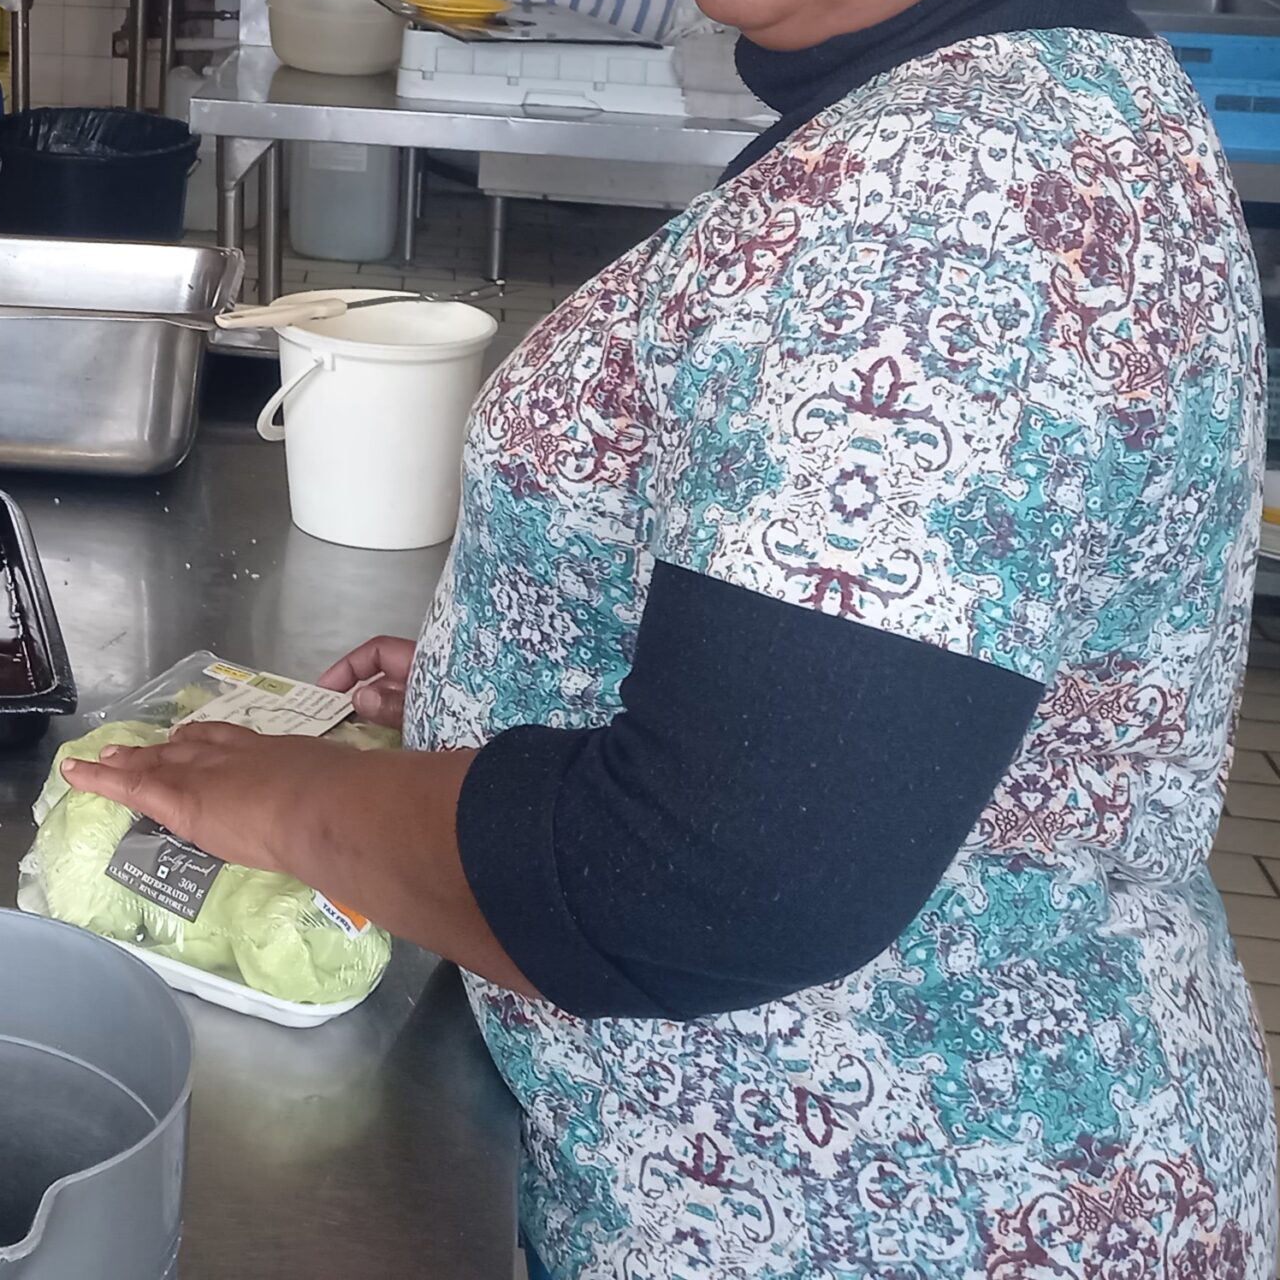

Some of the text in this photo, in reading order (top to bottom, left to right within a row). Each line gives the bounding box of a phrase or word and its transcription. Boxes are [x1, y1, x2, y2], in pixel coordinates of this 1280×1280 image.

[122, 861, 143, 878] KEEP
[109, 866, 130, 881] CLASS
[138, 883, 159, 900] RINSE
[157, 894, 184, 911] BEFORE
[178, 877, 205, 899] 300 g
[323, 903, 351, 932] TAX FREE
